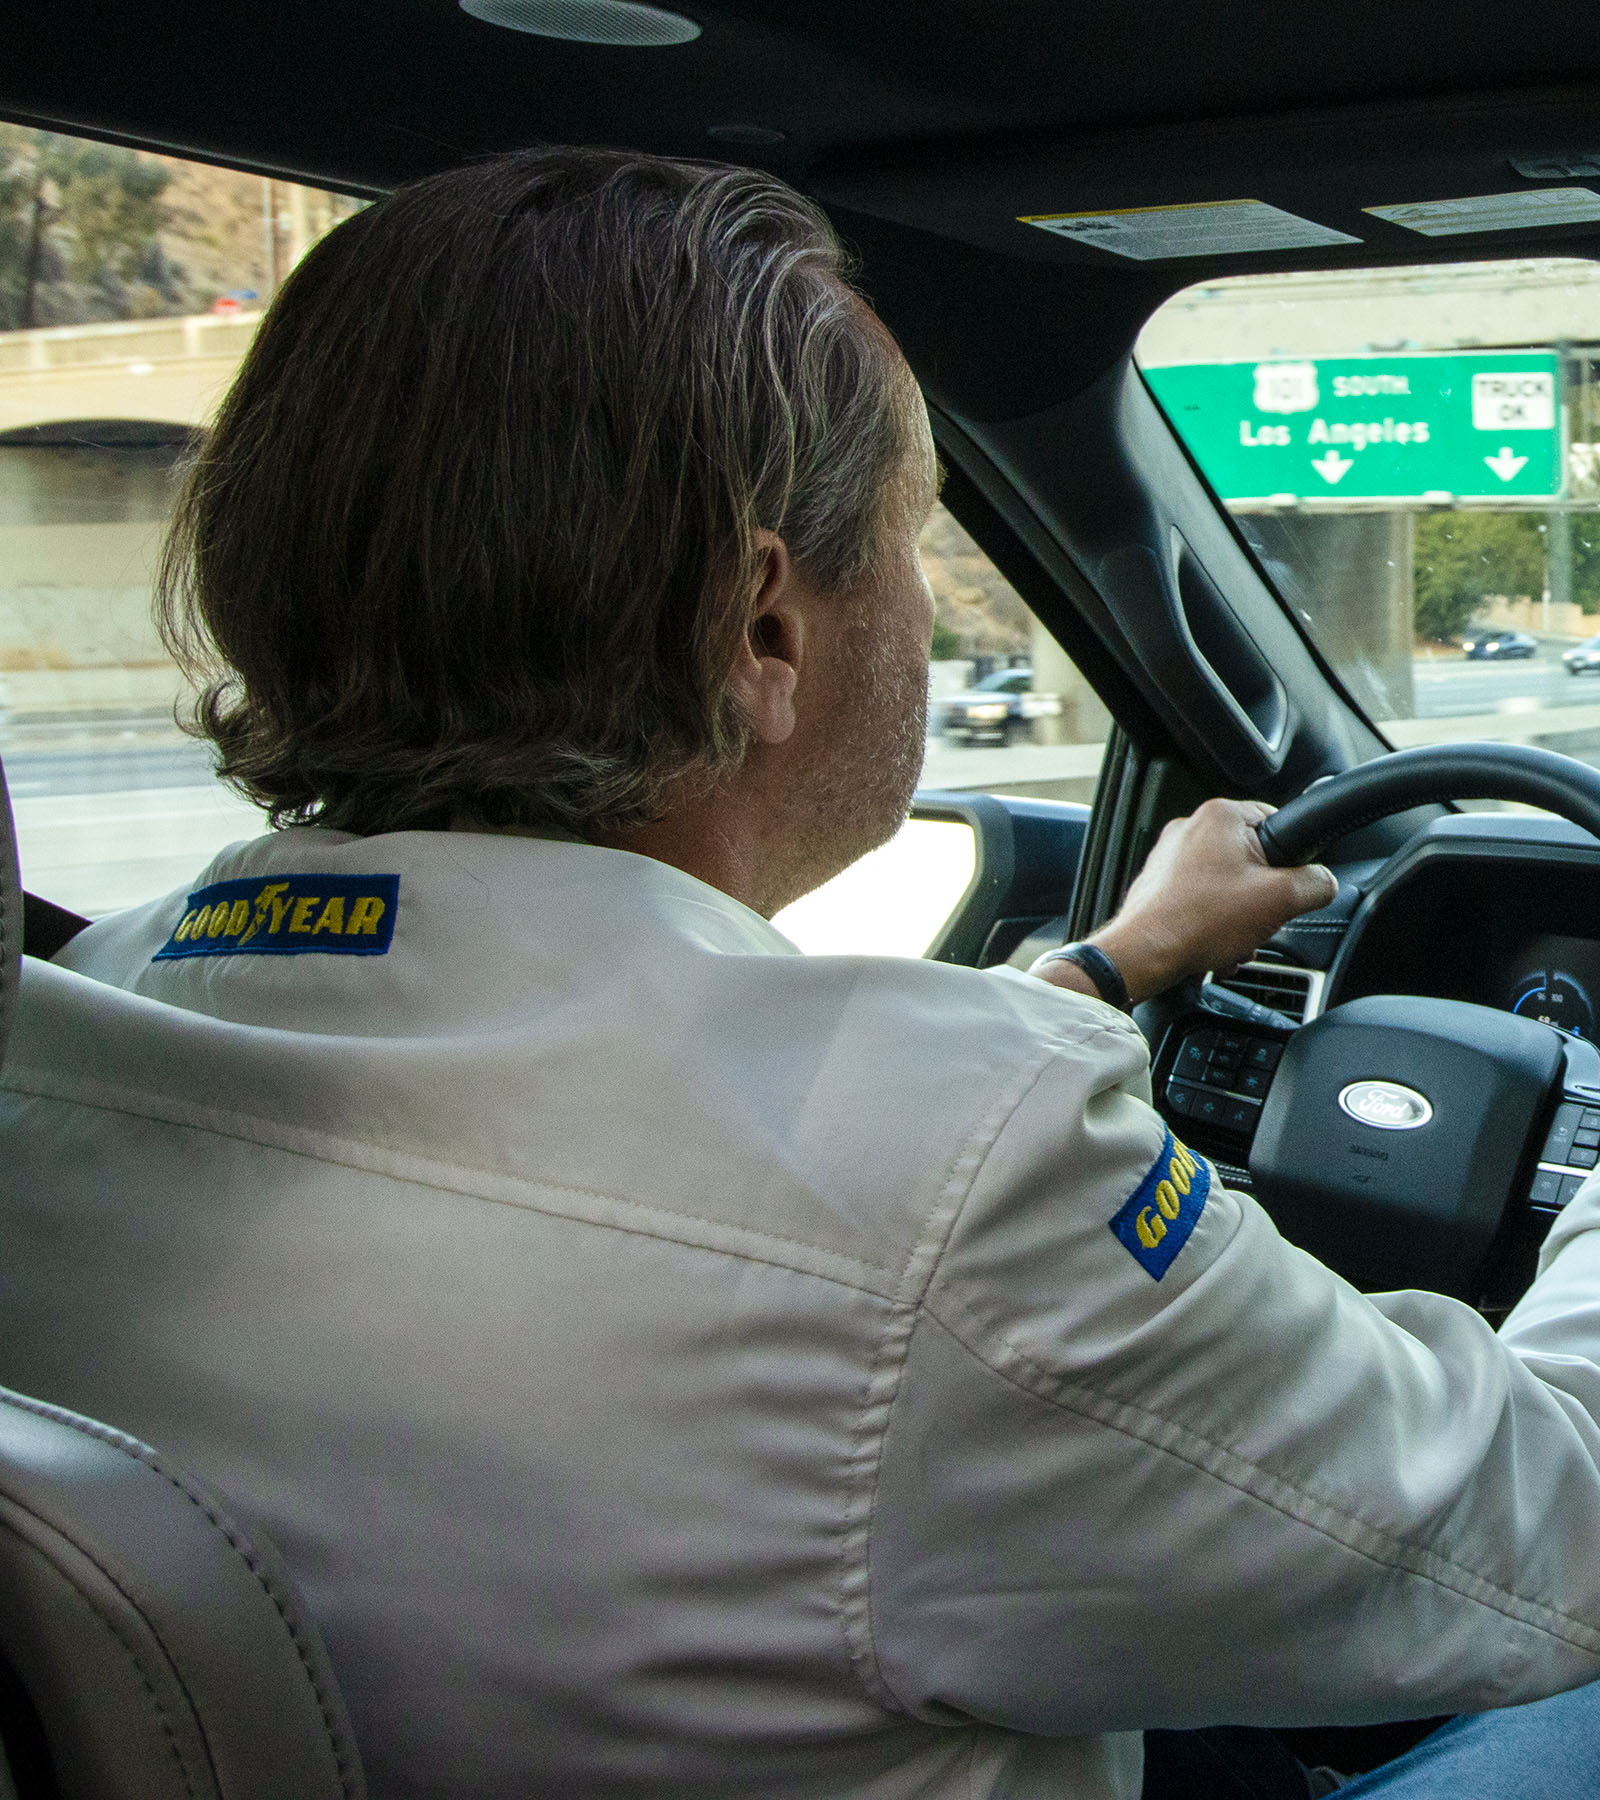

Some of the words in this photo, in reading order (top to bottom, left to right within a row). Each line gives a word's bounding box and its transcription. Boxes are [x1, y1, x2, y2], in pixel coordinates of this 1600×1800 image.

[1332, 374, 1409, 398] SOUTH
[1479, 379, 1551, 398] TRUCK
[1499, 403, 1528, 422] OK
[1239, 419, 1291, 446] Los
[1306, 417, 1431, 451] Angeles
[173, 882, 387, 946] GOODYEAR
[1358, 1088, 1410, 1119] Ford
